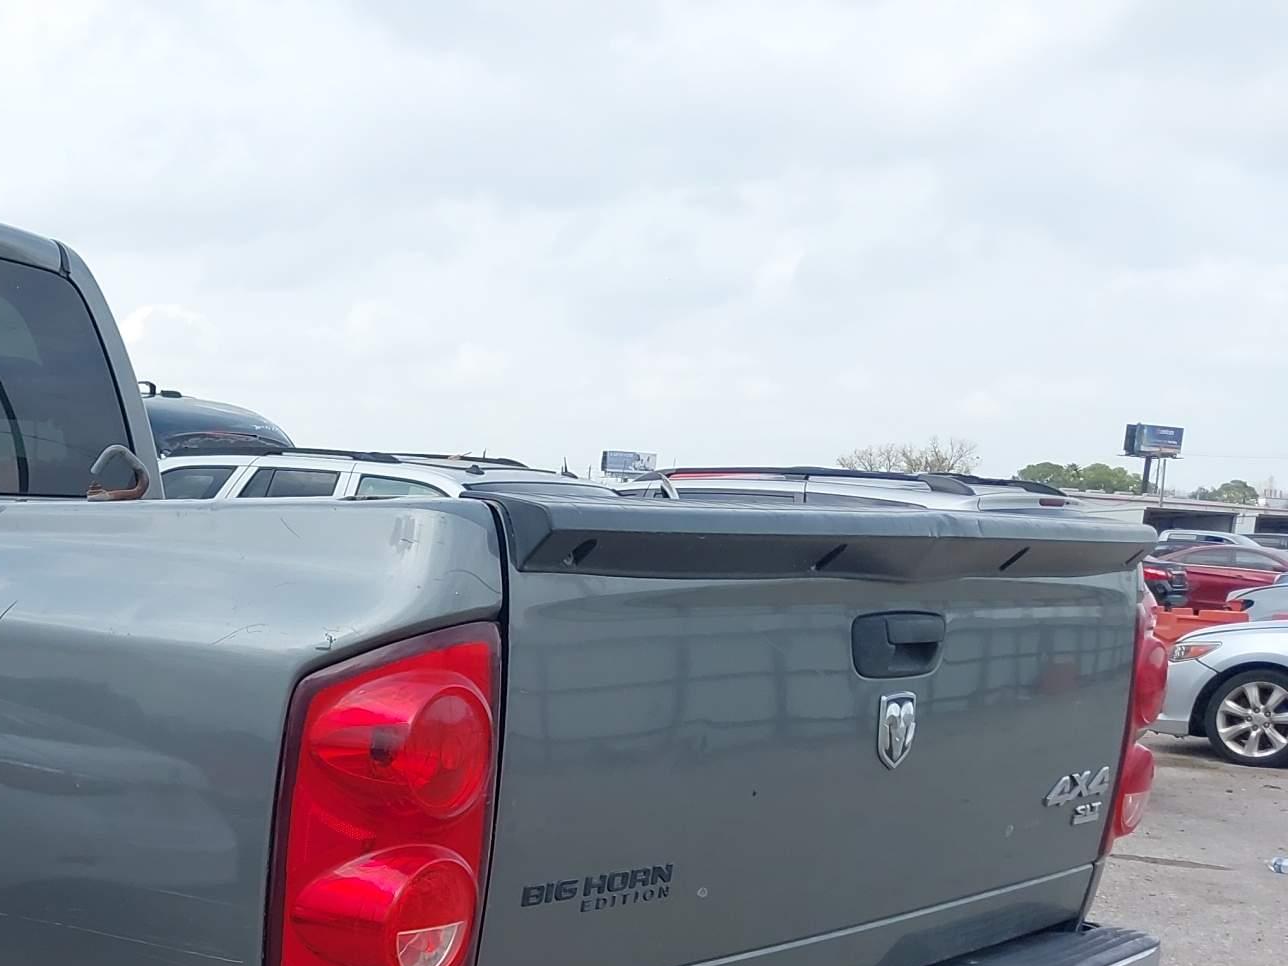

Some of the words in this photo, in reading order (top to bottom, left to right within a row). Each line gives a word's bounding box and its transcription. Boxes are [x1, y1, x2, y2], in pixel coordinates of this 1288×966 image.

[1074, 801, 1102, 817] SLT
[521, 880, 579, 908] BIG
[583, 864, 674, 897] HORN
[580, 886, 670, 912] EDITION
